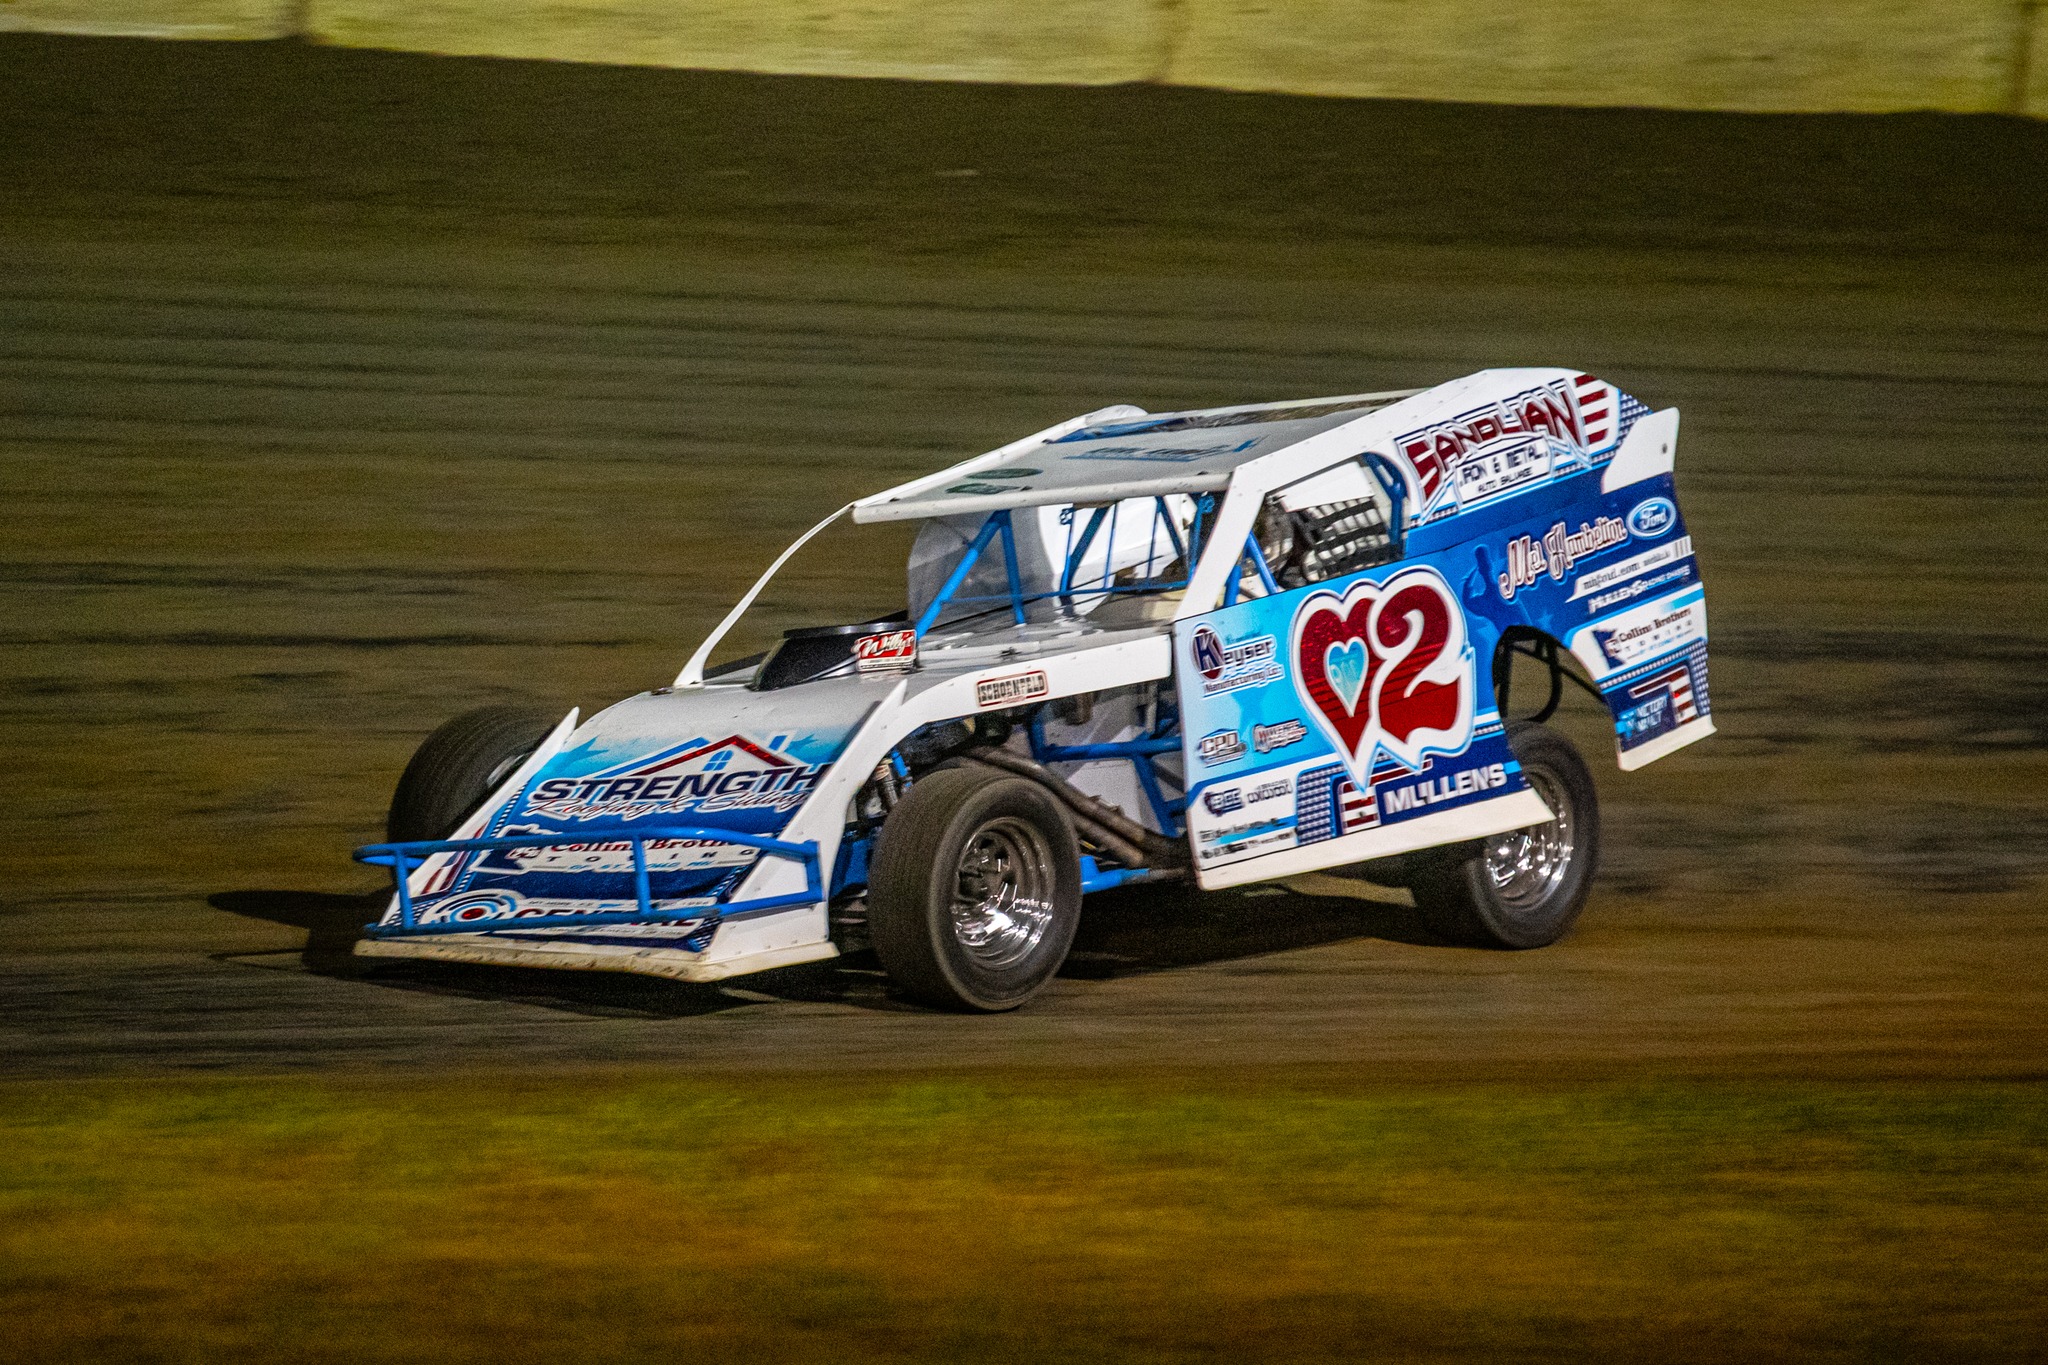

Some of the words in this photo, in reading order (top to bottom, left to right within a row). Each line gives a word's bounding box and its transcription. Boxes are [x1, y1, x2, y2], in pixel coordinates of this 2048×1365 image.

[1638, 505, 1669, 530] Ford
[534, 763, 829, 800] STRENGTH
[1383, 763, 1508, 815] MULLENS
